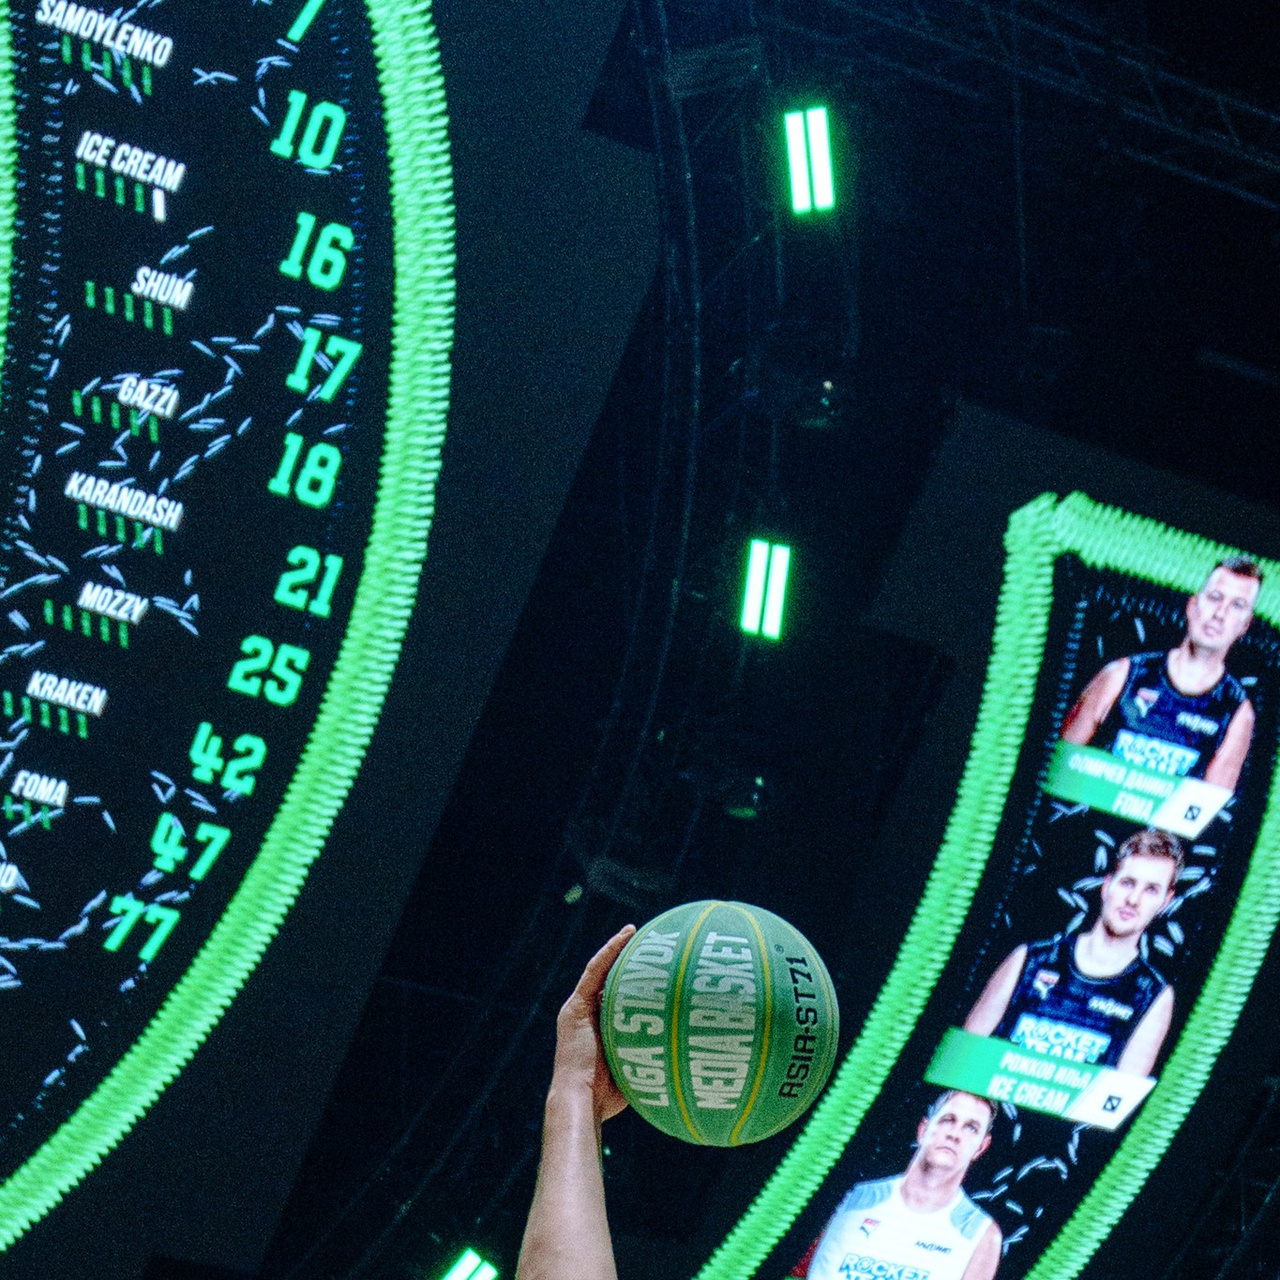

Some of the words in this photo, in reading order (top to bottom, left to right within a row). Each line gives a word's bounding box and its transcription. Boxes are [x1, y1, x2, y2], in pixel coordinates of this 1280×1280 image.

[35, 0, 174, 68] SAMOYLENKO
[75, 131, 115, 167] ICE
[111, 143, 187, 192] CREAM
[270, 90, 346, 169] 10
[280, 213, 354, 290] 16
[131, 266, 195, 310] SHUM
[118, 376, 180, 417] GAZZI
[286, 327, 363, 402] 17
[65, 471, 184, 532] KARANDASH
[268, 433, 342, 508] 18
[79, 582, 148, 625] MOZZY
[274, 546, 344, 619] 21
[26, 671, 108, 717] KRAKEN
[227, 635, 310, 706] 25
[11, 771, 68, 808] FOMA
[189, 722, 267, 796] 42
[151, 813, 231, 880] 47
[103, 896, 180, 962] 77
[613, 930, 681, 1035] STAVOK
[689, 931, 756, 1030] BASKET
[616, 1046, 669, 1107] LIGA
[688, 1035, 755, 1109] MEDIA
[986, 1075, 1017, 1099] ICE
[1013, 1082, 1070, 1114] CREAM
